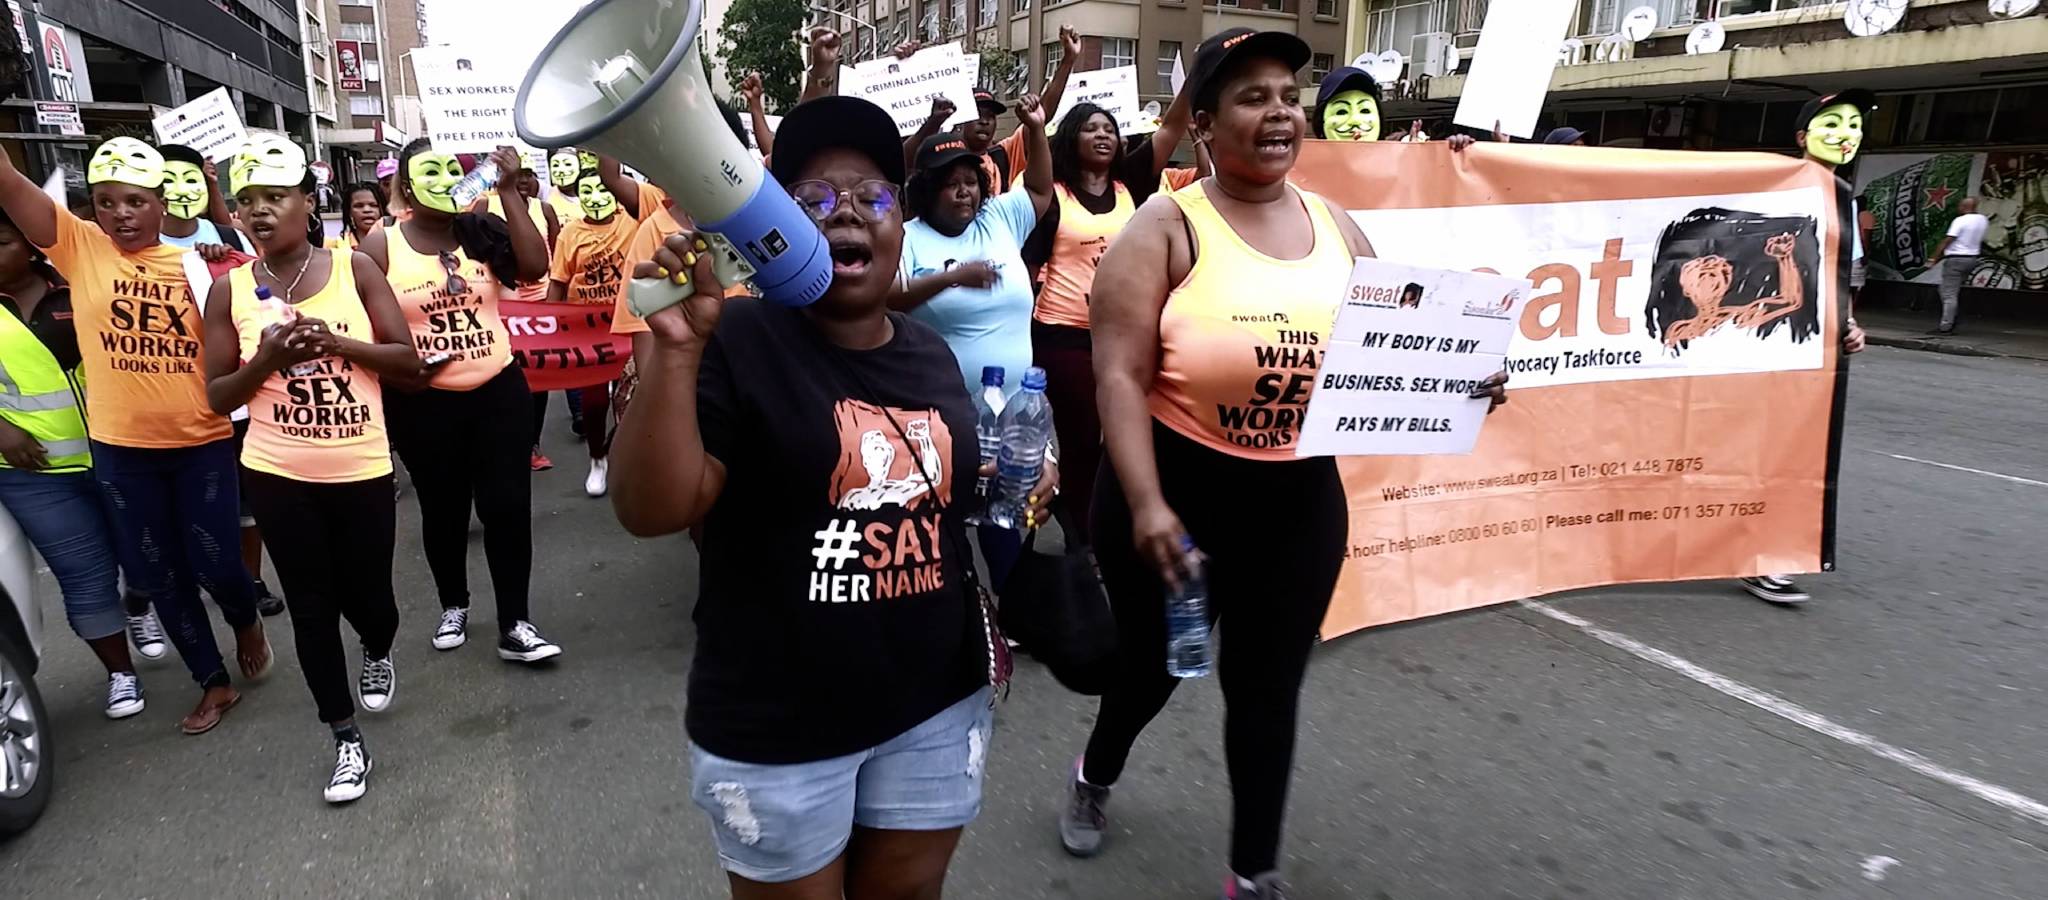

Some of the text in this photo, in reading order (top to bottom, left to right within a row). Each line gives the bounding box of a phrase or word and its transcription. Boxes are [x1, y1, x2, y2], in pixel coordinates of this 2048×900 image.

[429, 85, 516, 96] SEX WORKERS
[865, 66, 960, 94] CRIMINALISATION
[891, 96, 922, 110] KILLS
[1091, 91, 1115, 101] WORK
[444, 108, 507, 118] THE RIGHT
[170, 111, 225, 140] SEX WORKERS HAVE
[436, 133, 465, 141] FREE
[471, 131, 504, 140] FROM
[192, 132, 208, 143] RIGHT
[209, 132, 236, 148] VIOLENCE
[1896, 161, 1926, 265] Heineken
[585, 265, 622, 286] SEX
[114, 279, 194, 304] WHAT A
[1351, 285, 1401, 304] sweat
[1519, 238, 1633, 341] at
[420, 295, 483, 313] WHAT A
[111, 299, 188, 336] SEX
[428, 307, 482, 334] SEX
[1232, 313, 1272, 323] sweat
[100, 331, 198, 358] WORKER
[416, 330, 495, 351] WORKER
[1277, 330, 1319, 345] THIS
[1362, 332, 1480, 355] MY BODY IS MY
[471, 347, 492, 360] LIKE
[1564, 348, 1642, 370] Taskforce
[111, 357, 195, 374] LOOKS LIKE
[341, 359, 353, 374] A
[287, 376, 356, 406] SEX
[1248, 373, 1312, 407] SE
[1323, 374, 1405, 392] BUSINESS.
[1410, 377, 1441, 393] SEX
[273, 403, 371, 427] WORKER
[1335, 417, 1452, 433] PAYS MY BILLS.
[280, 425, 364, 439] LOOKS LIKE
[1226, 430, 1292, 448] LOOKS
[1382, 483, 1441, 501] Website:
[1570, 463, 1596, 479] Tel:
[1600, 461, 1627, 476] 021
[1632, 459, 1661, 473] 448
[1666, 457, 1704, 472] 7875
[1353, 543, 1385, 558] hour
[1388, 533, 1446, 553] helpline:
[1449, 525, 1481, 544] 0800
[1483, 523, 1499, 539] 60
[1502, 521, 1518, 535] 60
[1521, 518, 1537, 533] 60
[1546, 512, 1592, 529] Please
[1596, 509, 1624, 523] call
[1628, 511, 1657, 521] me:
[1662, 506, 1690, 520] 071
[1696, 503, 1724, 518] 357
[1730, 501, 1766, 517] 7632
[812, 513, 942, 570] #SAY
[809, 563, 944, 603] HER NAME
